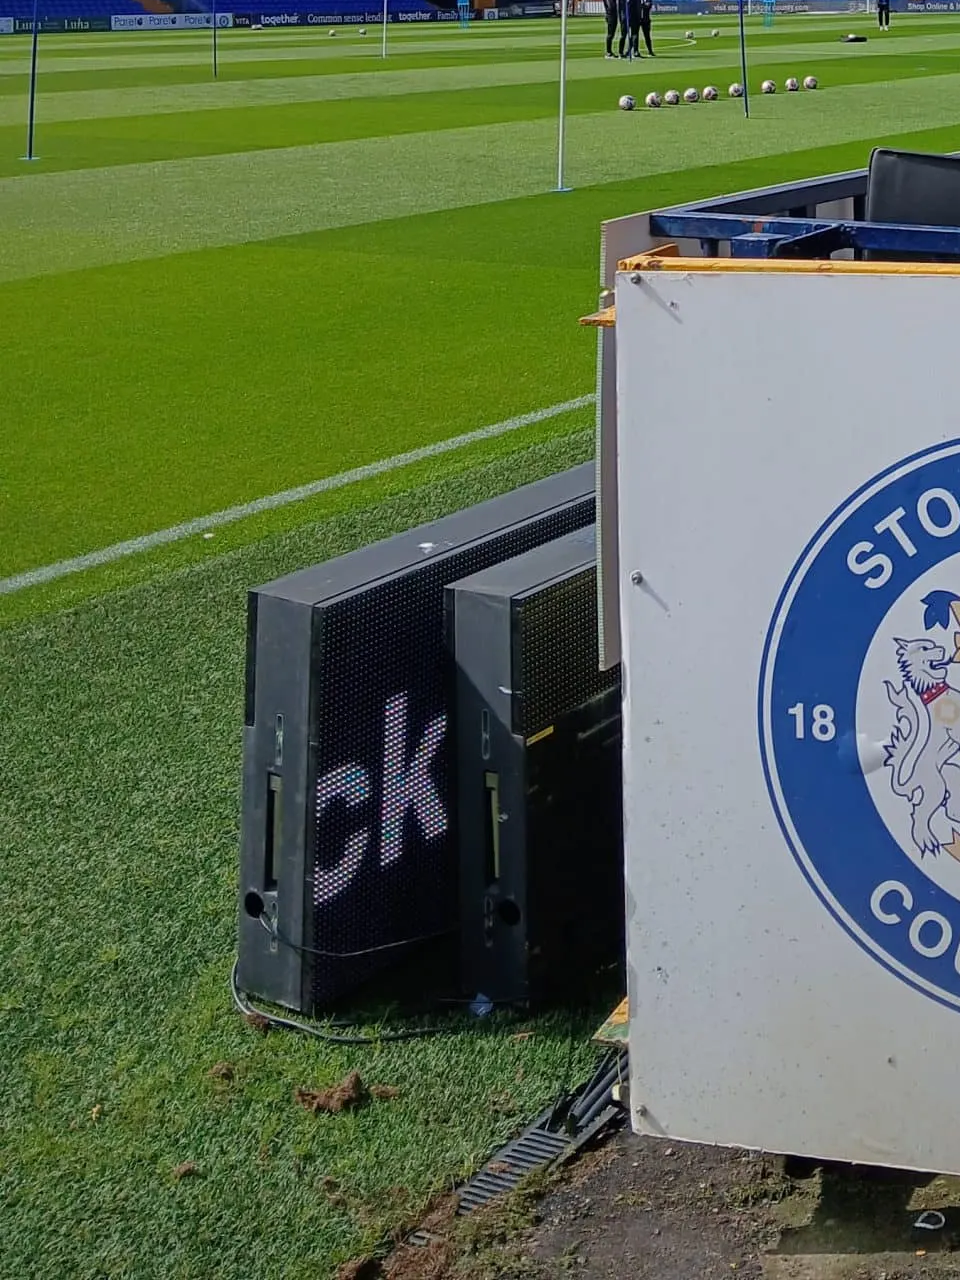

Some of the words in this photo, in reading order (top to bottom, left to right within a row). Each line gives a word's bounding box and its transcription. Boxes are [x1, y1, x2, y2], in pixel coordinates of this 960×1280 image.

[907, 2, 925, 12] Shop
[926, 2, 948, 11] Online
[307, 14, 342, 24] Common
[343, 15, 364, 24] sense
[787, 701, 836, 742] 18
